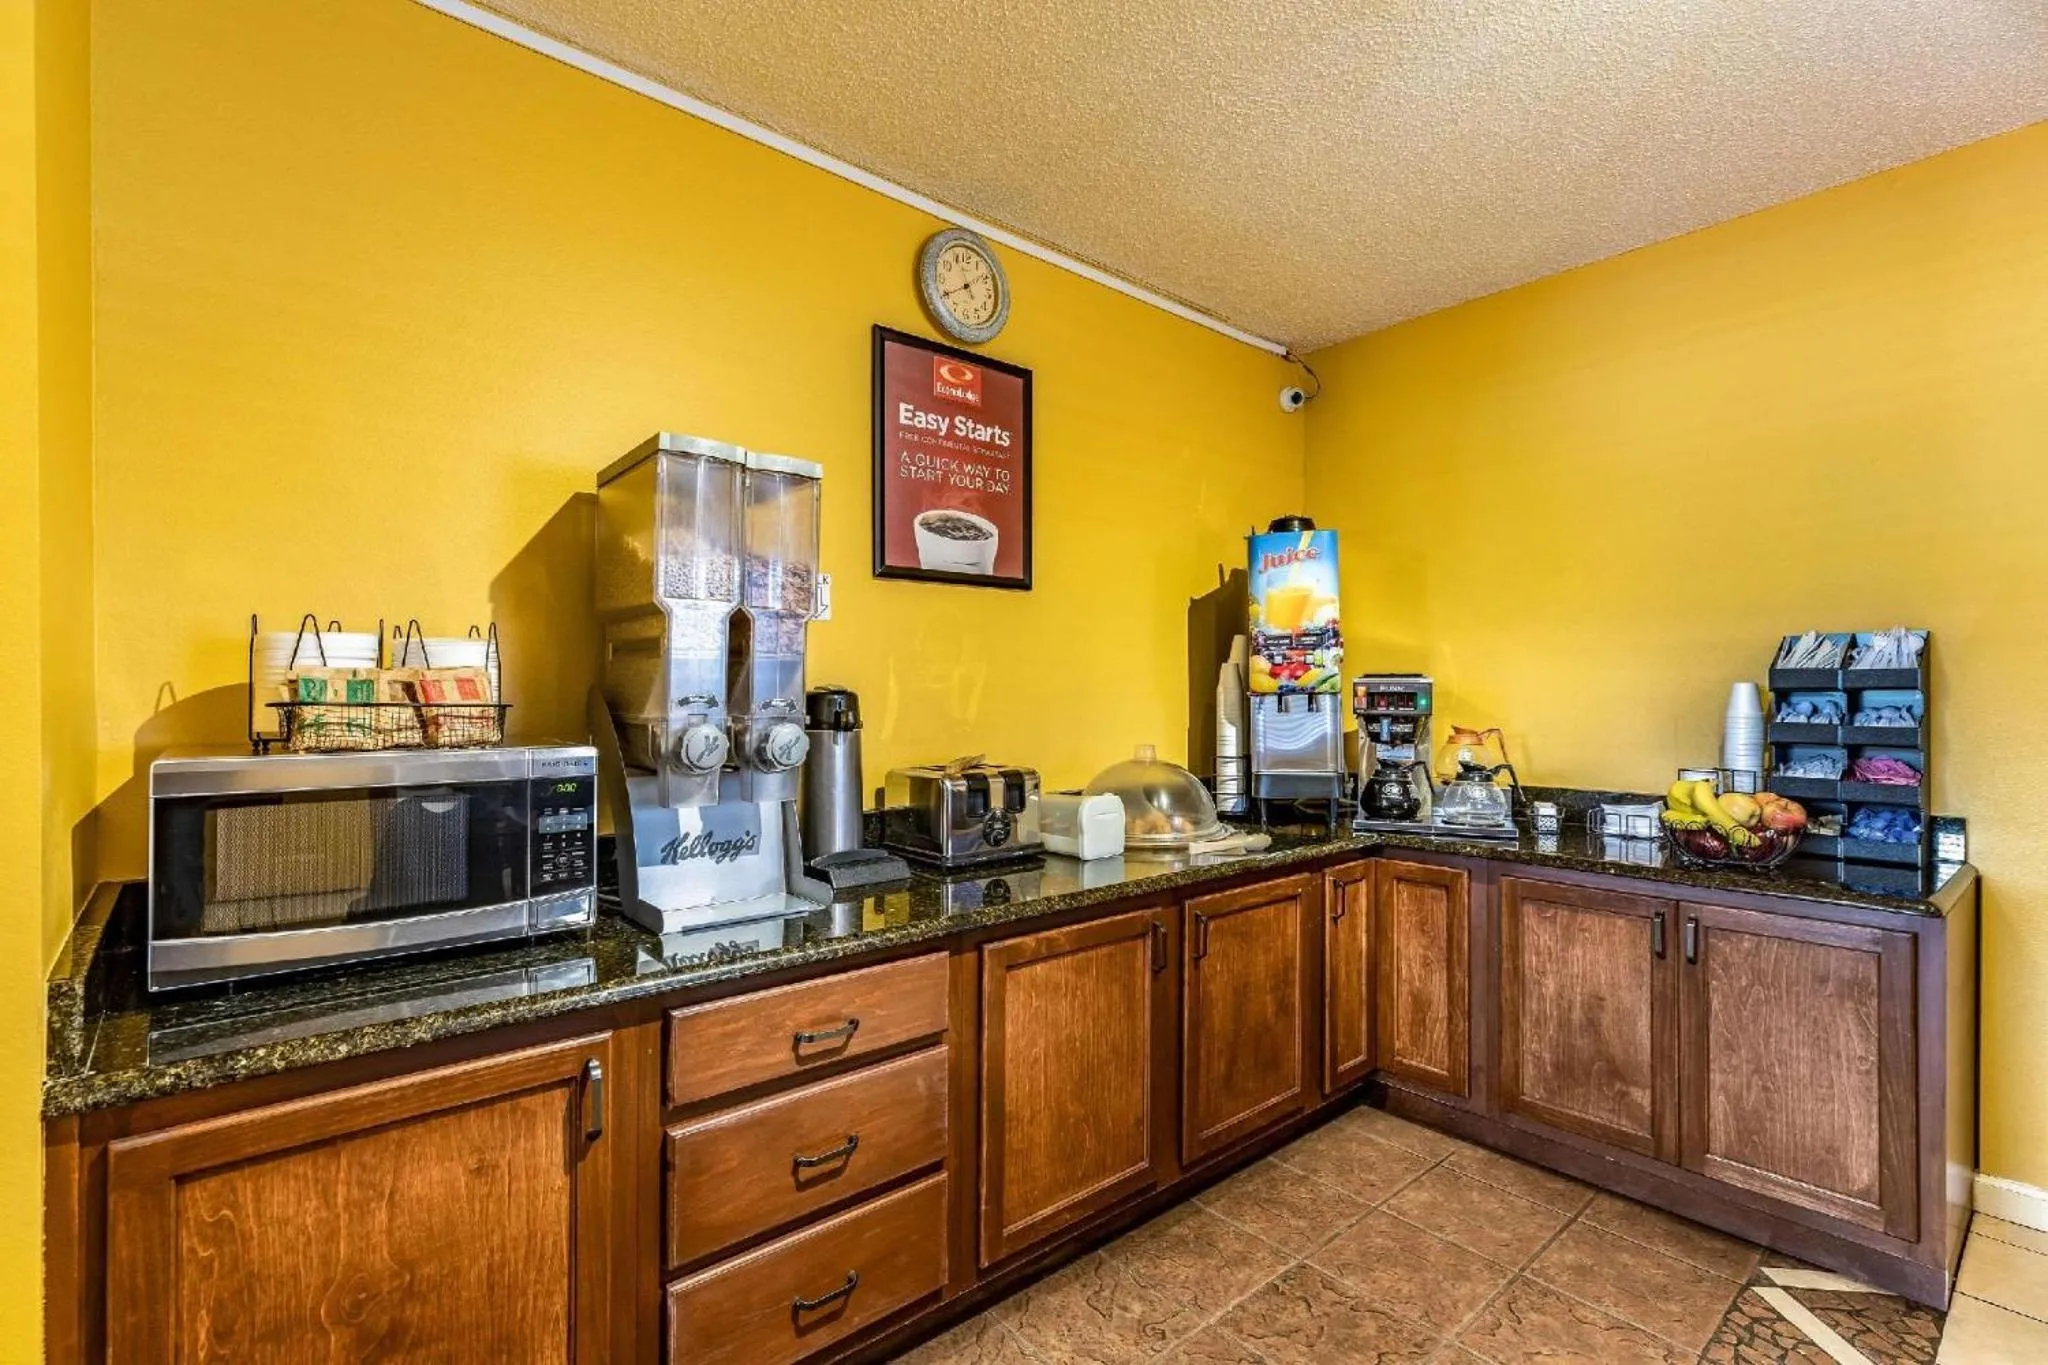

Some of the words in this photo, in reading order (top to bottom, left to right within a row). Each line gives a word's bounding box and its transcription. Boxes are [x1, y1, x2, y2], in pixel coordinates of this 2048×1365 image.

[899, 402, 950, 436] Easy
[954, 415, 1011, 447] Starts
[900, 451, 911, 464] A
[915, 454, 959, 473] QUICK
[963, 463, 991, 478] WAY
[995, 468, 1010, 482] TO
[900, 464, 943, 485] START
[948, 473, 983, 491] YOUR
[1259, 546, 1321, 575] Juice
[660, 829, 758, 866] Kellogg's
